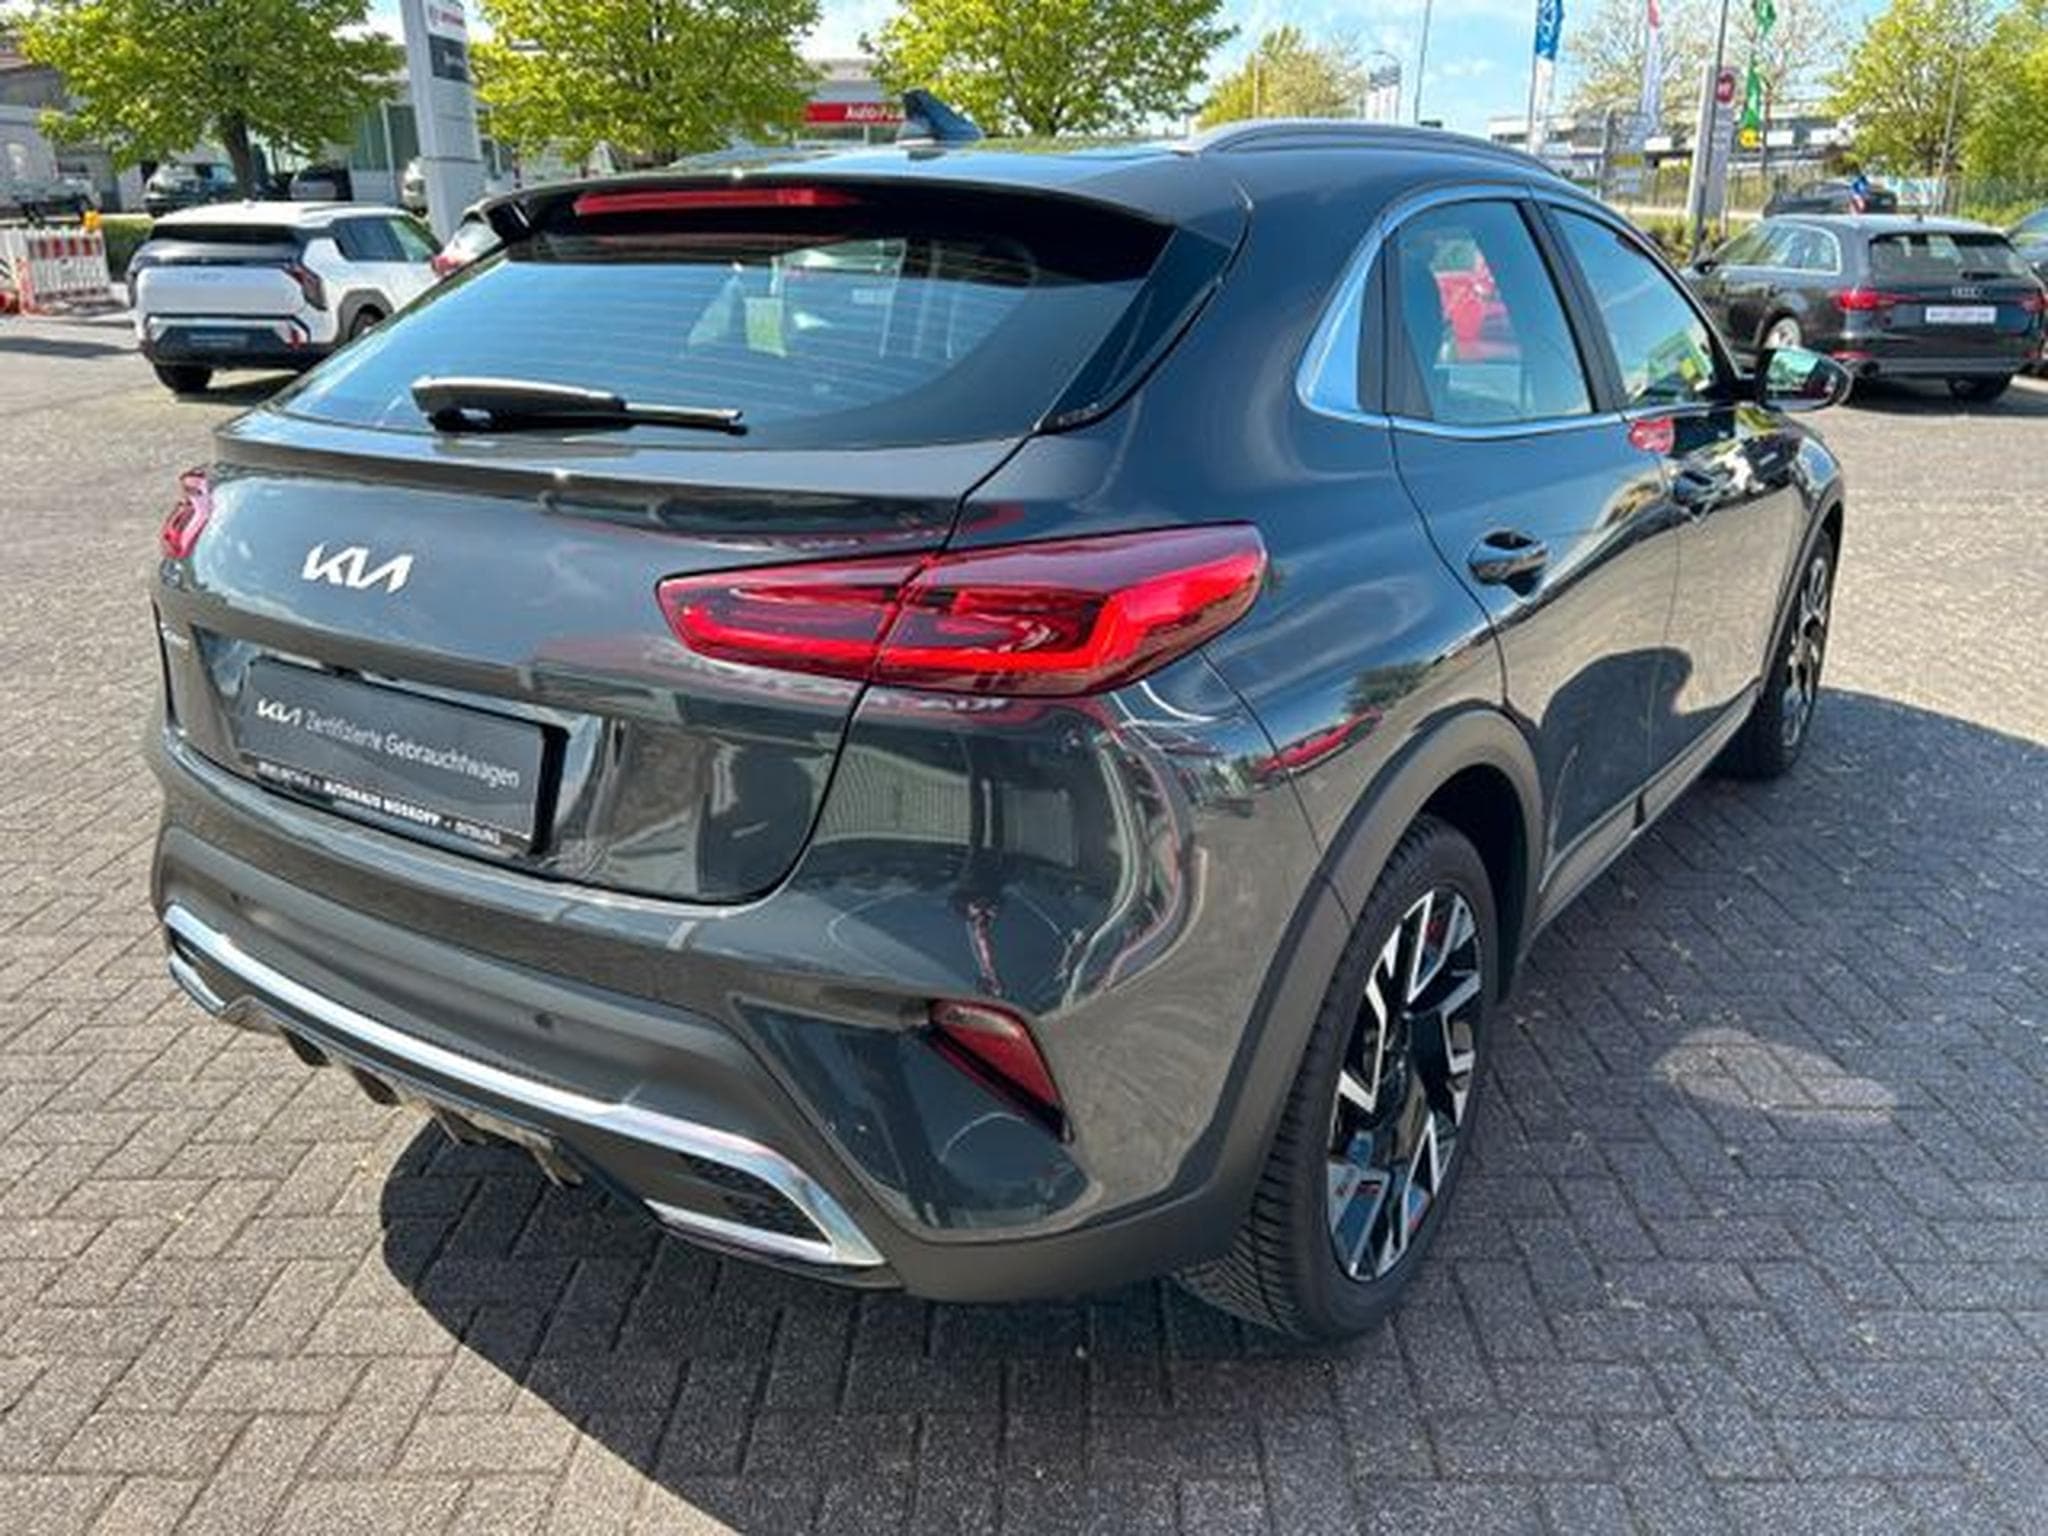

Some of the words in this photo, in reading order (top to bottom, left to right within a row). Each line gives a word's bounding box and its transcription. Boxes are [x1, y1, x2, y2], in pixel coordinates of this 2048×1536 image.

[302, 542, 414, 593] KIA
[257, 698, 302, 727] KIA
[384, 732, 520, 788] Gebrauchtwagen
